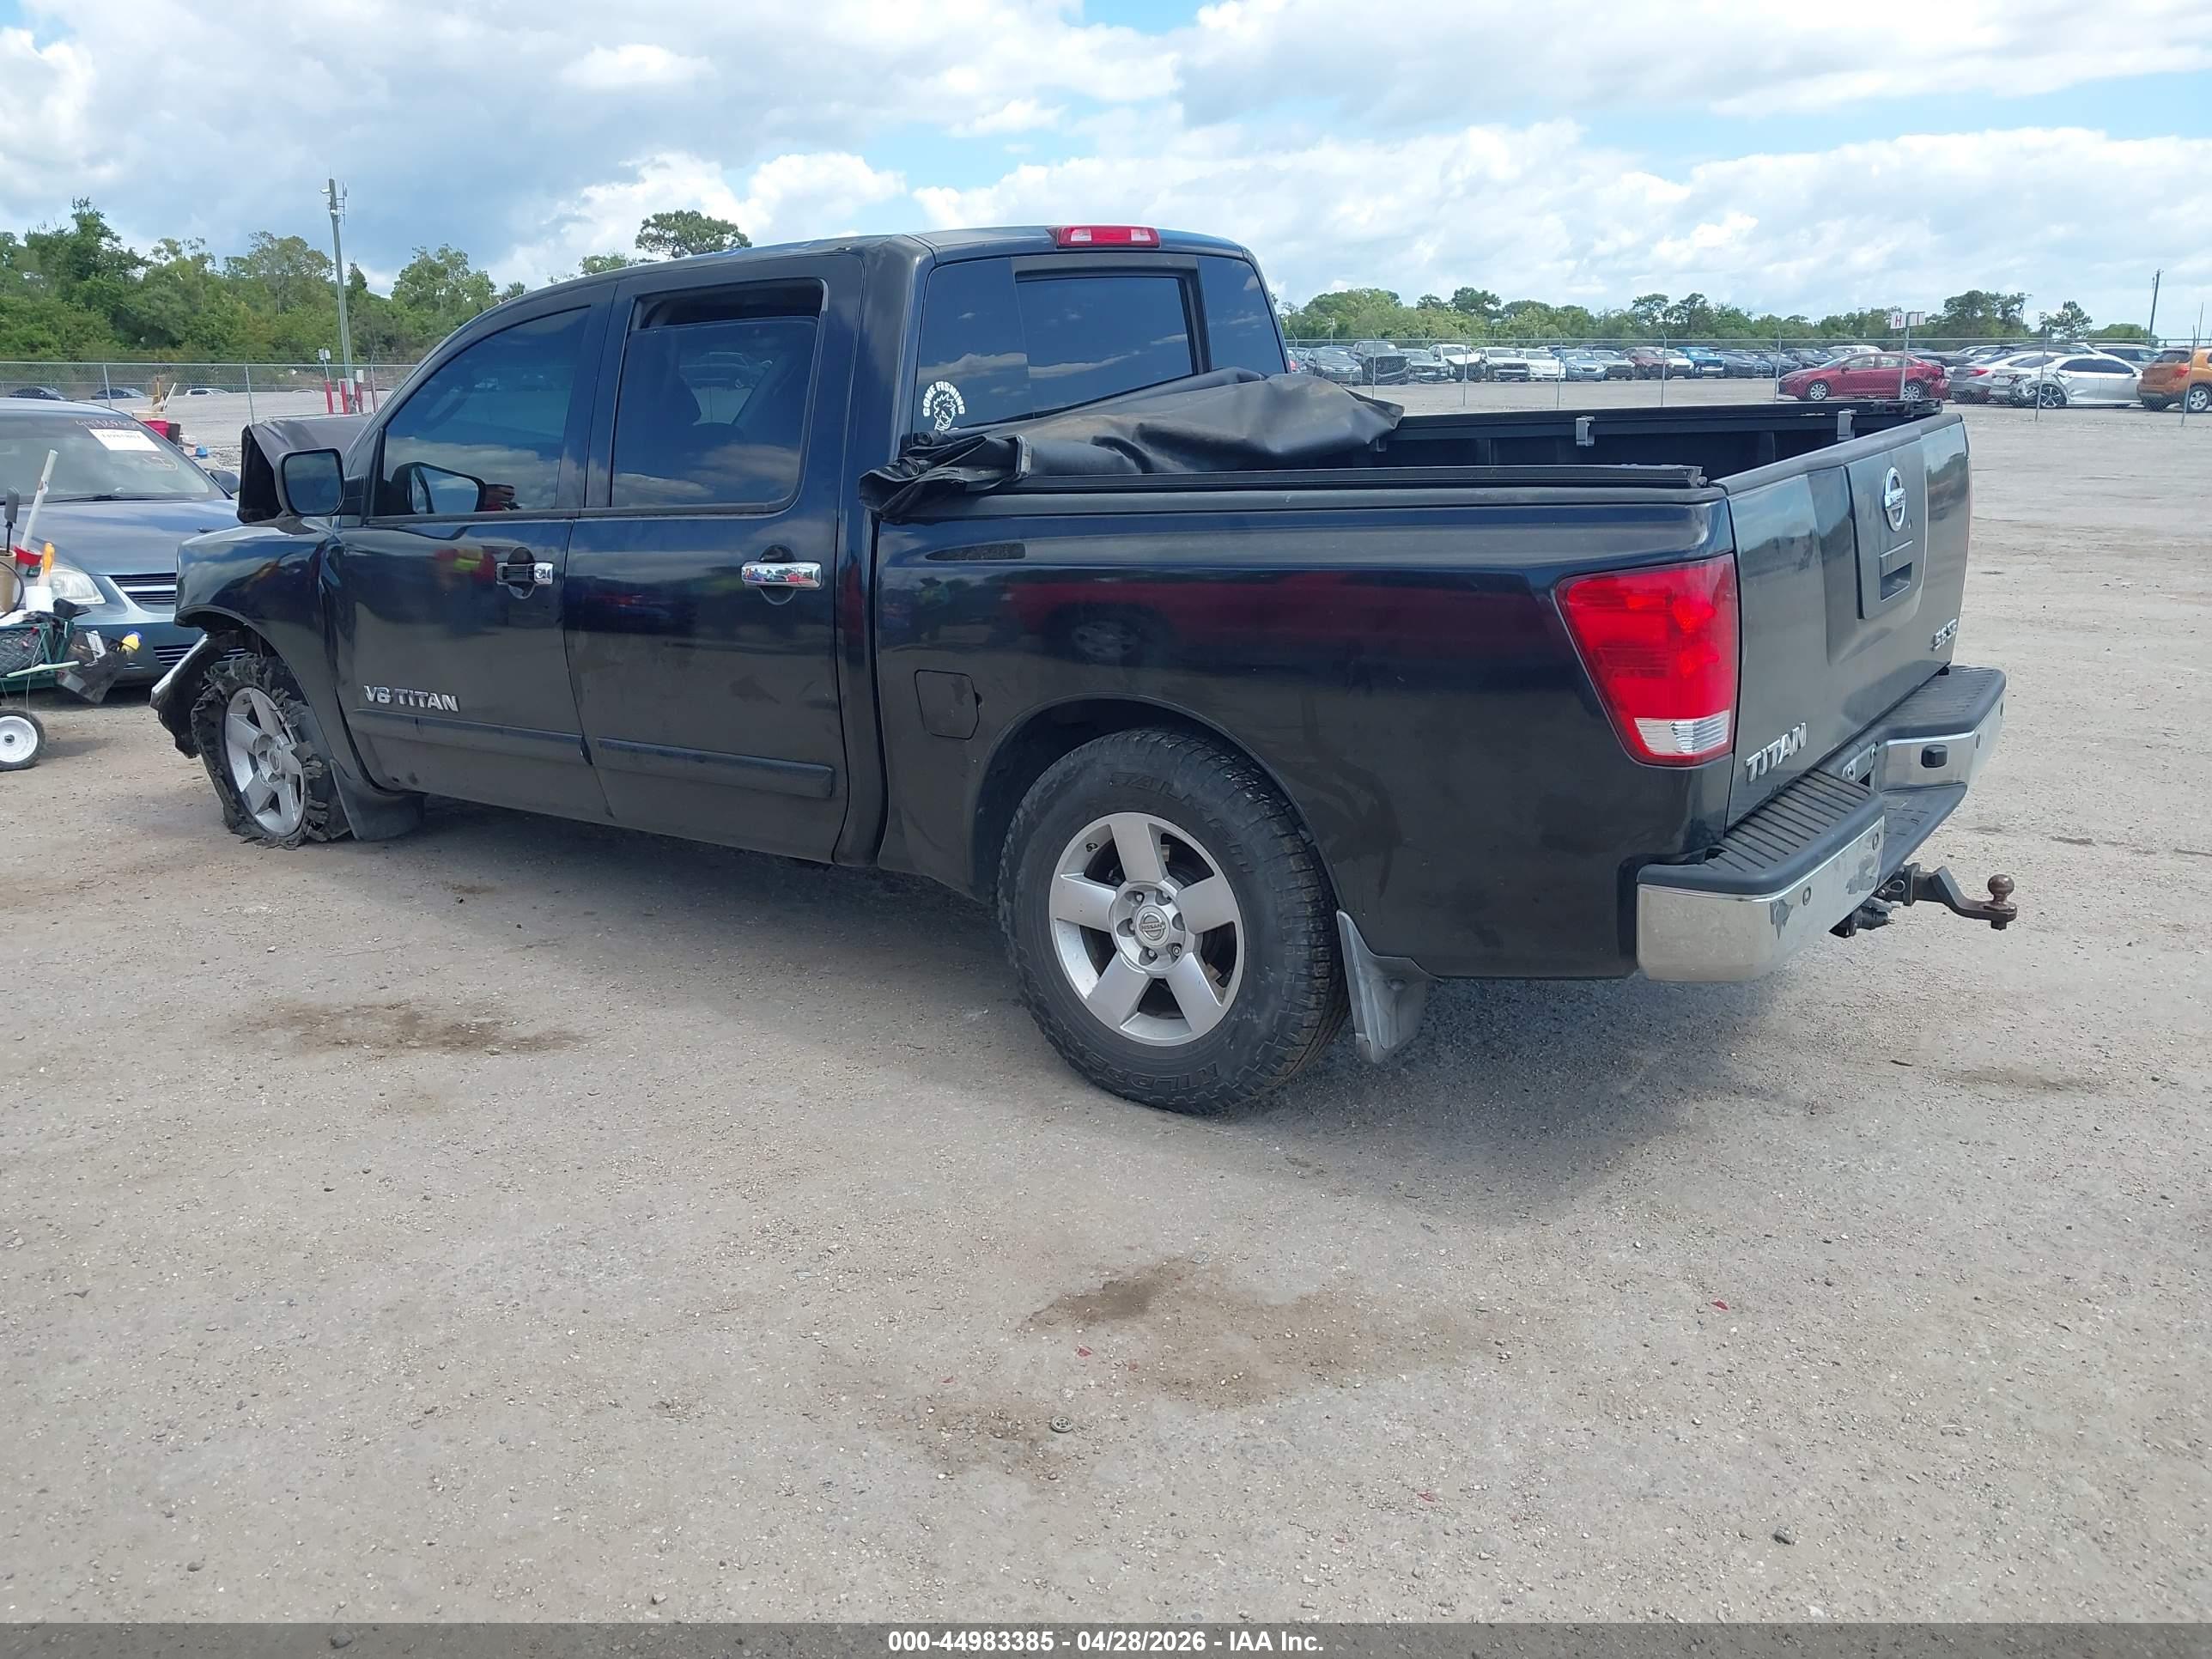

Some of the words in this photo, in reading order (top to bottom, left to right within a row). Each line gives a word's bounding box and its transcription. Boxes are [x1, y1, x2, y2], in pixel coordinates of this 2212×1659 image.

[1894, 314, 1902, 327] H
[923, 384, 937, 417] GONE
[935, 380, 965, 415] FISHING
[363, 685, 392, 705] V8
[394, 688, 459, 713] TITAN
[1745, 722, 1807, 782] TITAN
